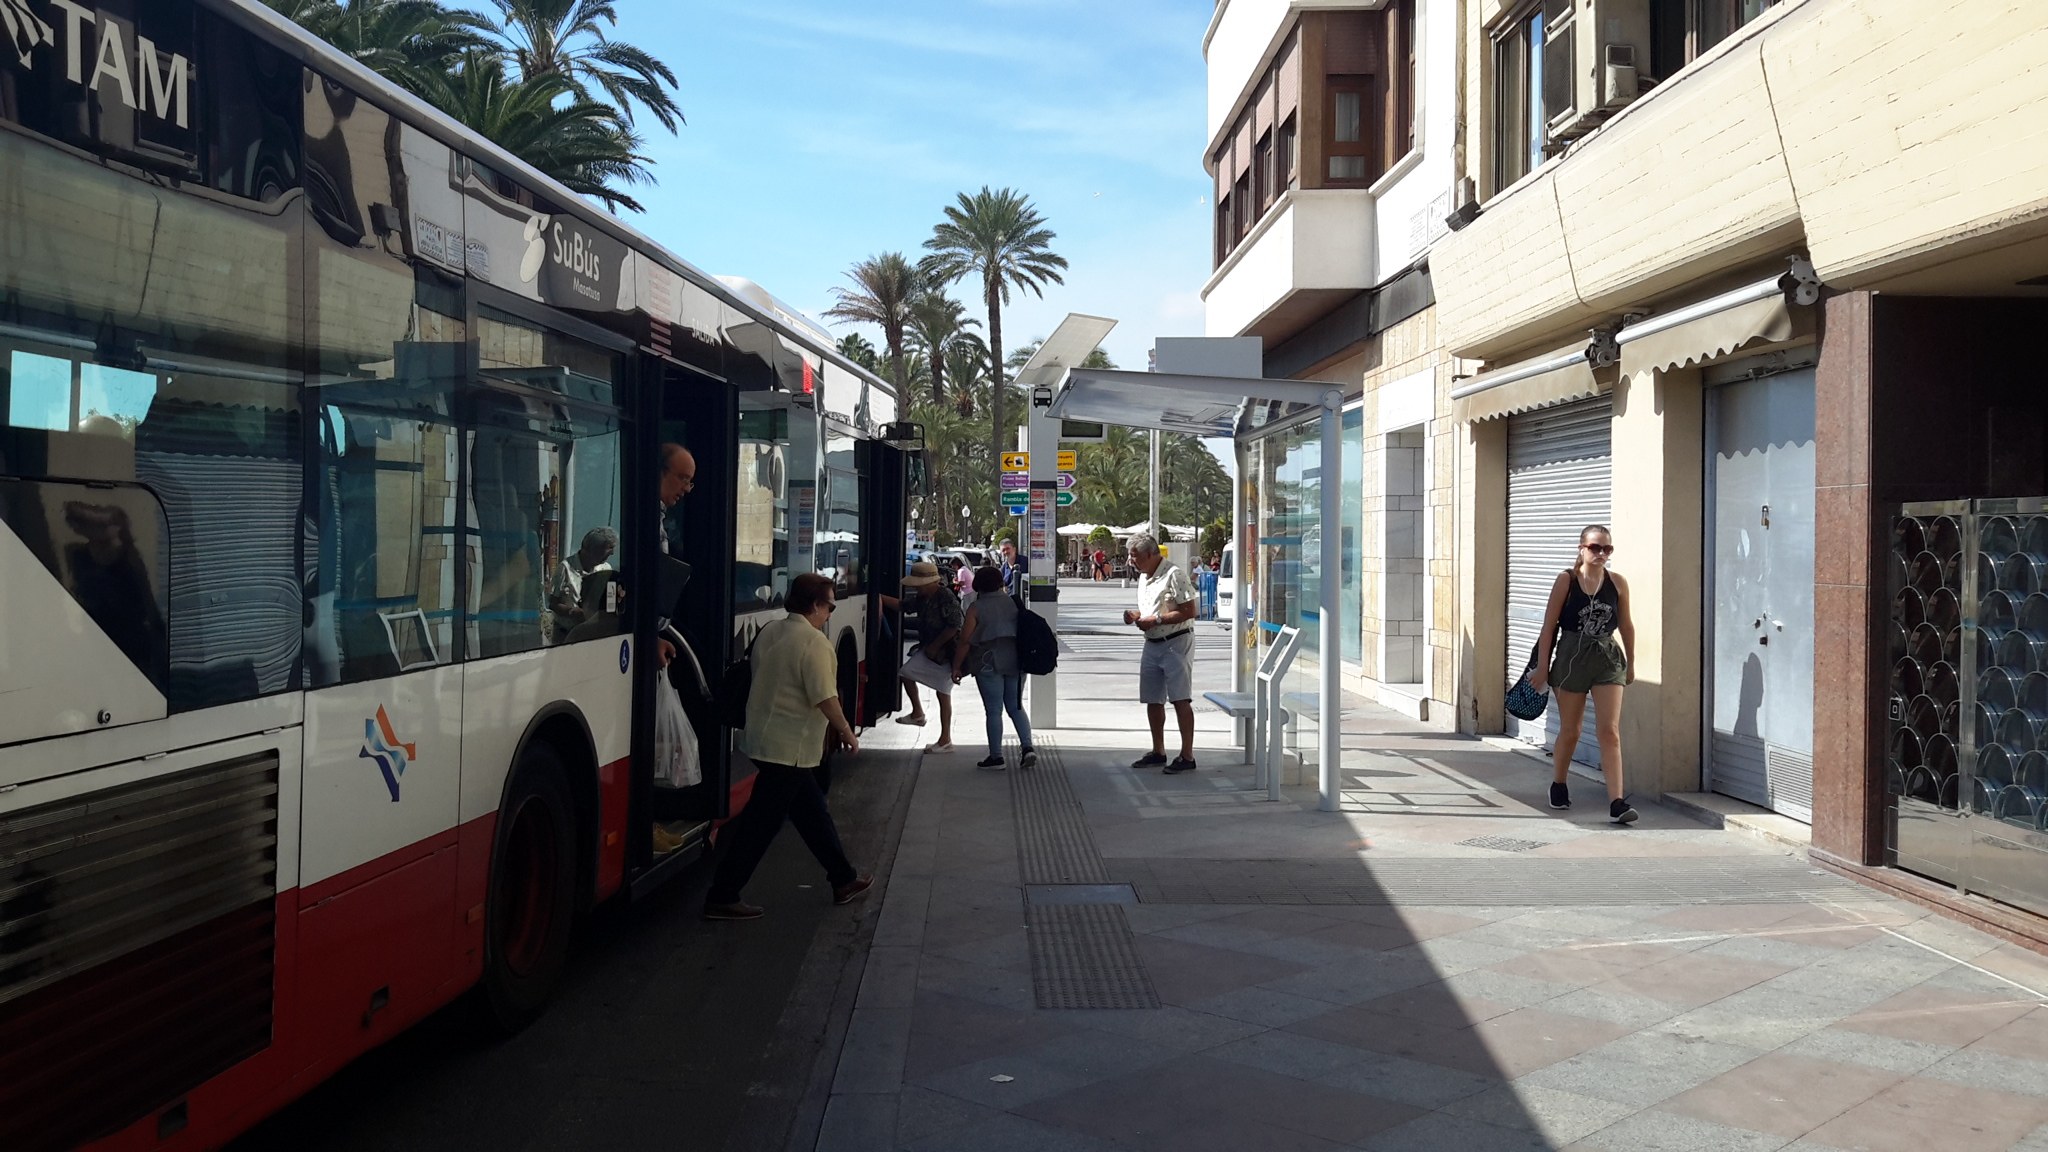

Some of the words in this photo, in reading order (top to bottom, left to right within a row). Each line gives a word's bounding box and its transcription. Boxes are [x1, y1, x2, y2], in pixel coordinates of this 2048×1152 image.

[51, 0, 188, 130] TAM
[553, 221, 600, 281] SuBús
[572, 276, 600, 301] Masatusa
